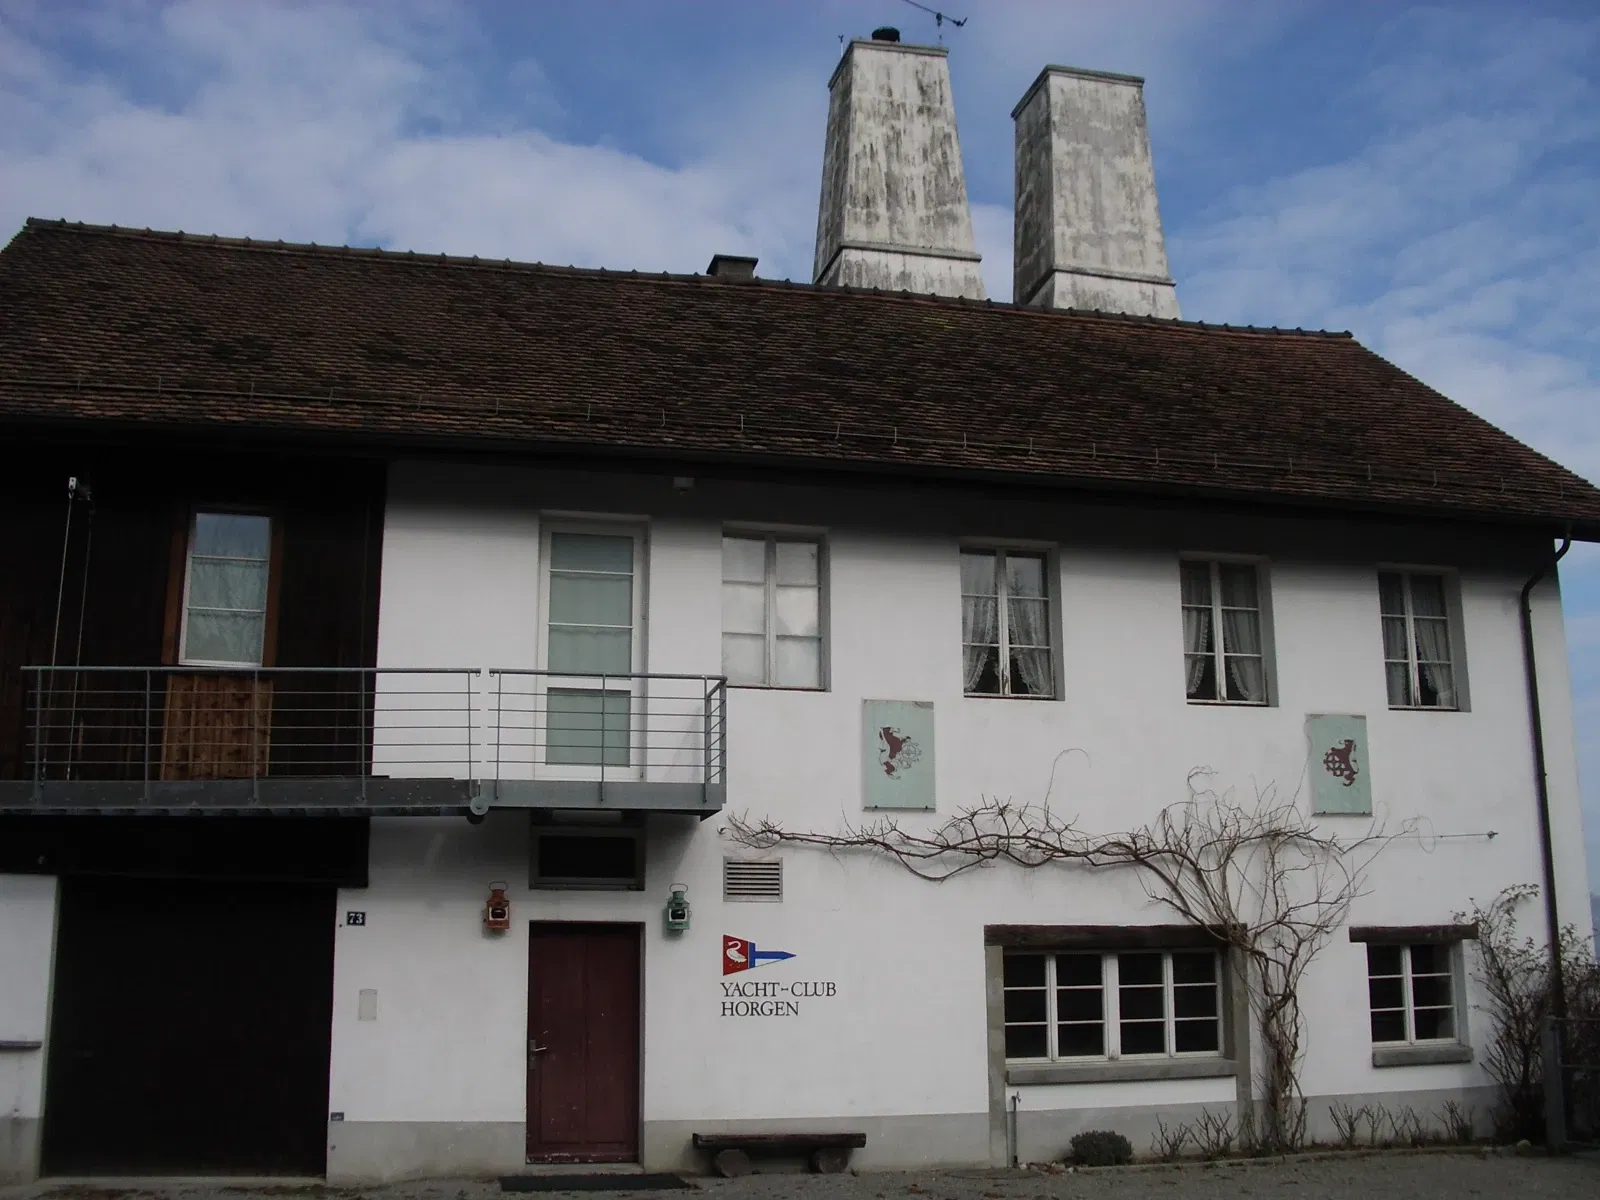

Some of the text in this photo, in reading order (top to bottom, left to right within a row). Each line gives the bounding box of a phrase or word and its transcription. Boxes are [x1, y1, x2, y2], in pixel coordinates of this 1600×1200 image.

[348, 912, 363, 924] 73
[720, 981, 837, 998] YACHT-CLUB
[720, 1000, 800, 1017] HORGEN
